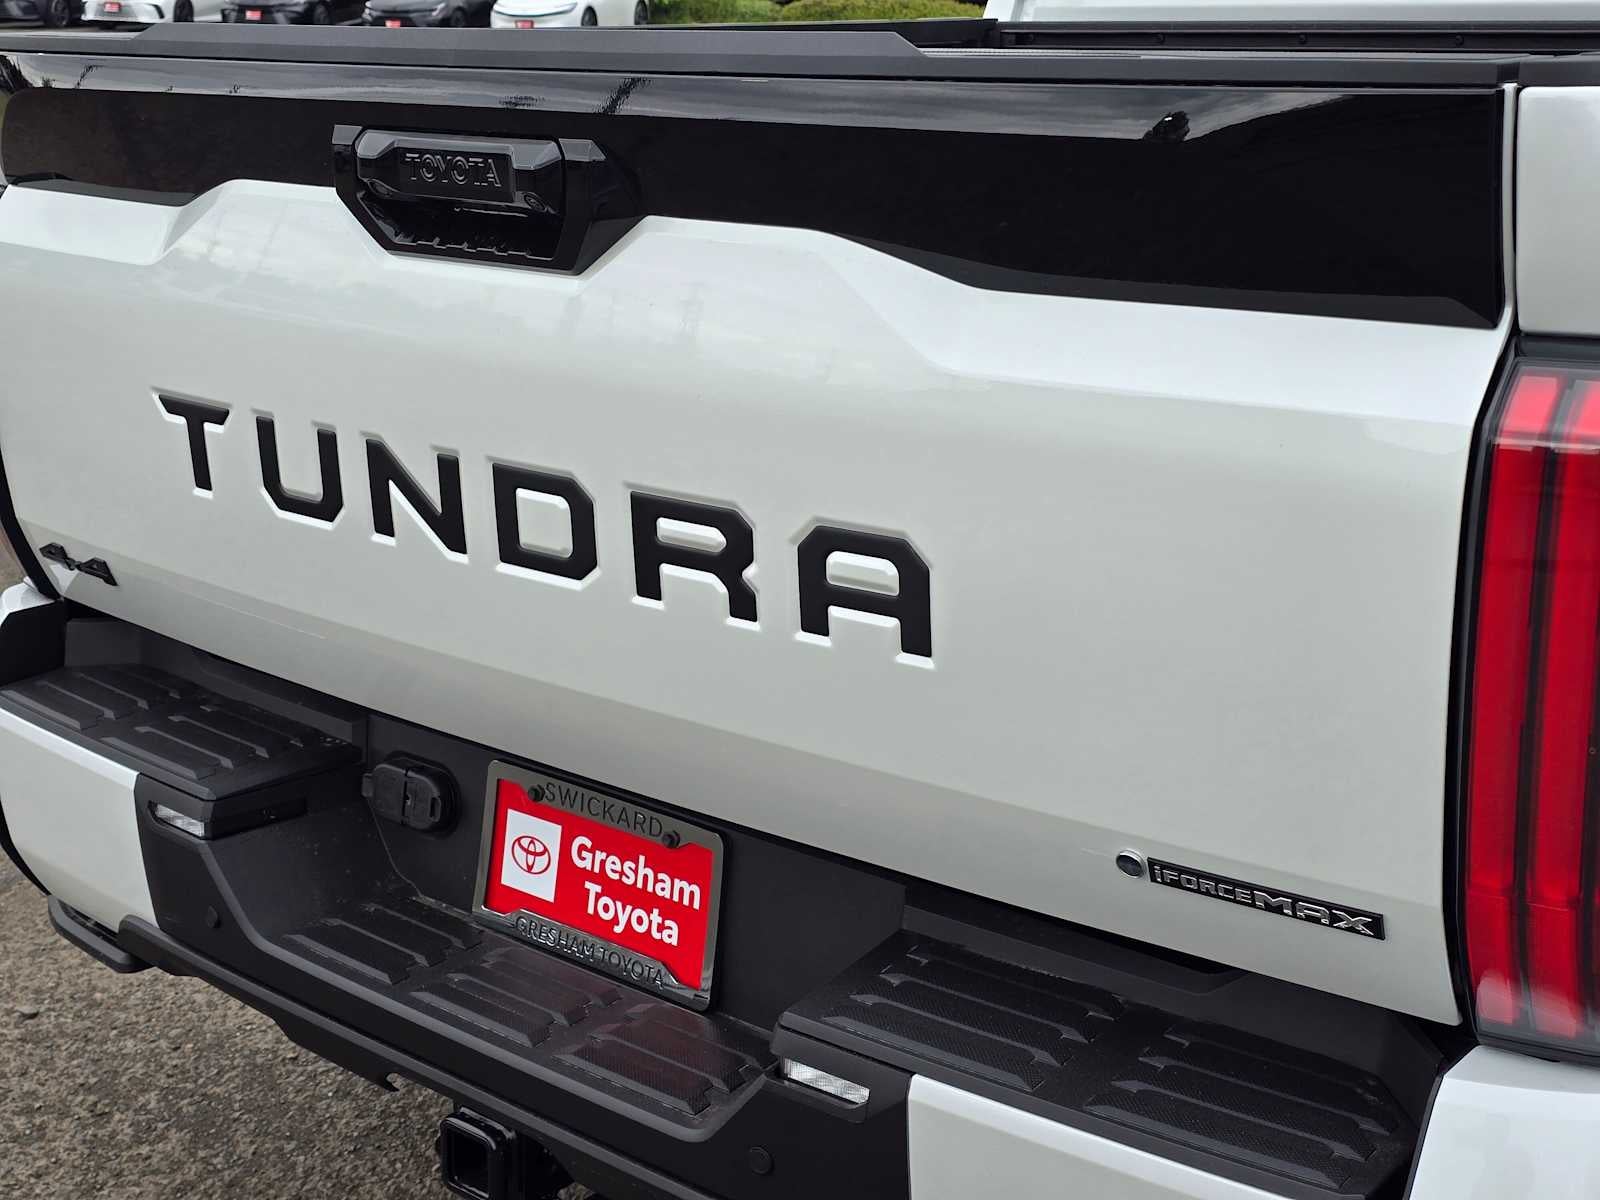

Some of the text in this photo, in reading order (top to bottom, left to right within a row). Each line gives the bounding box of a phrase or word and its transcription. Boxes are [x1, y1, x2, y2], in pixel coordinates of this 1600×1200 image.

[404, 152, 502, 187] TOYOTA
[156, 392, 935, 660] TUNDRA
[544, 782, 664, 840] SWICKARD
[570, 835, 702, 911] Gresham
[583, 880, 680, 946] Toyota
[515, 915, 665, 989] GRESHAM TOYOTA
